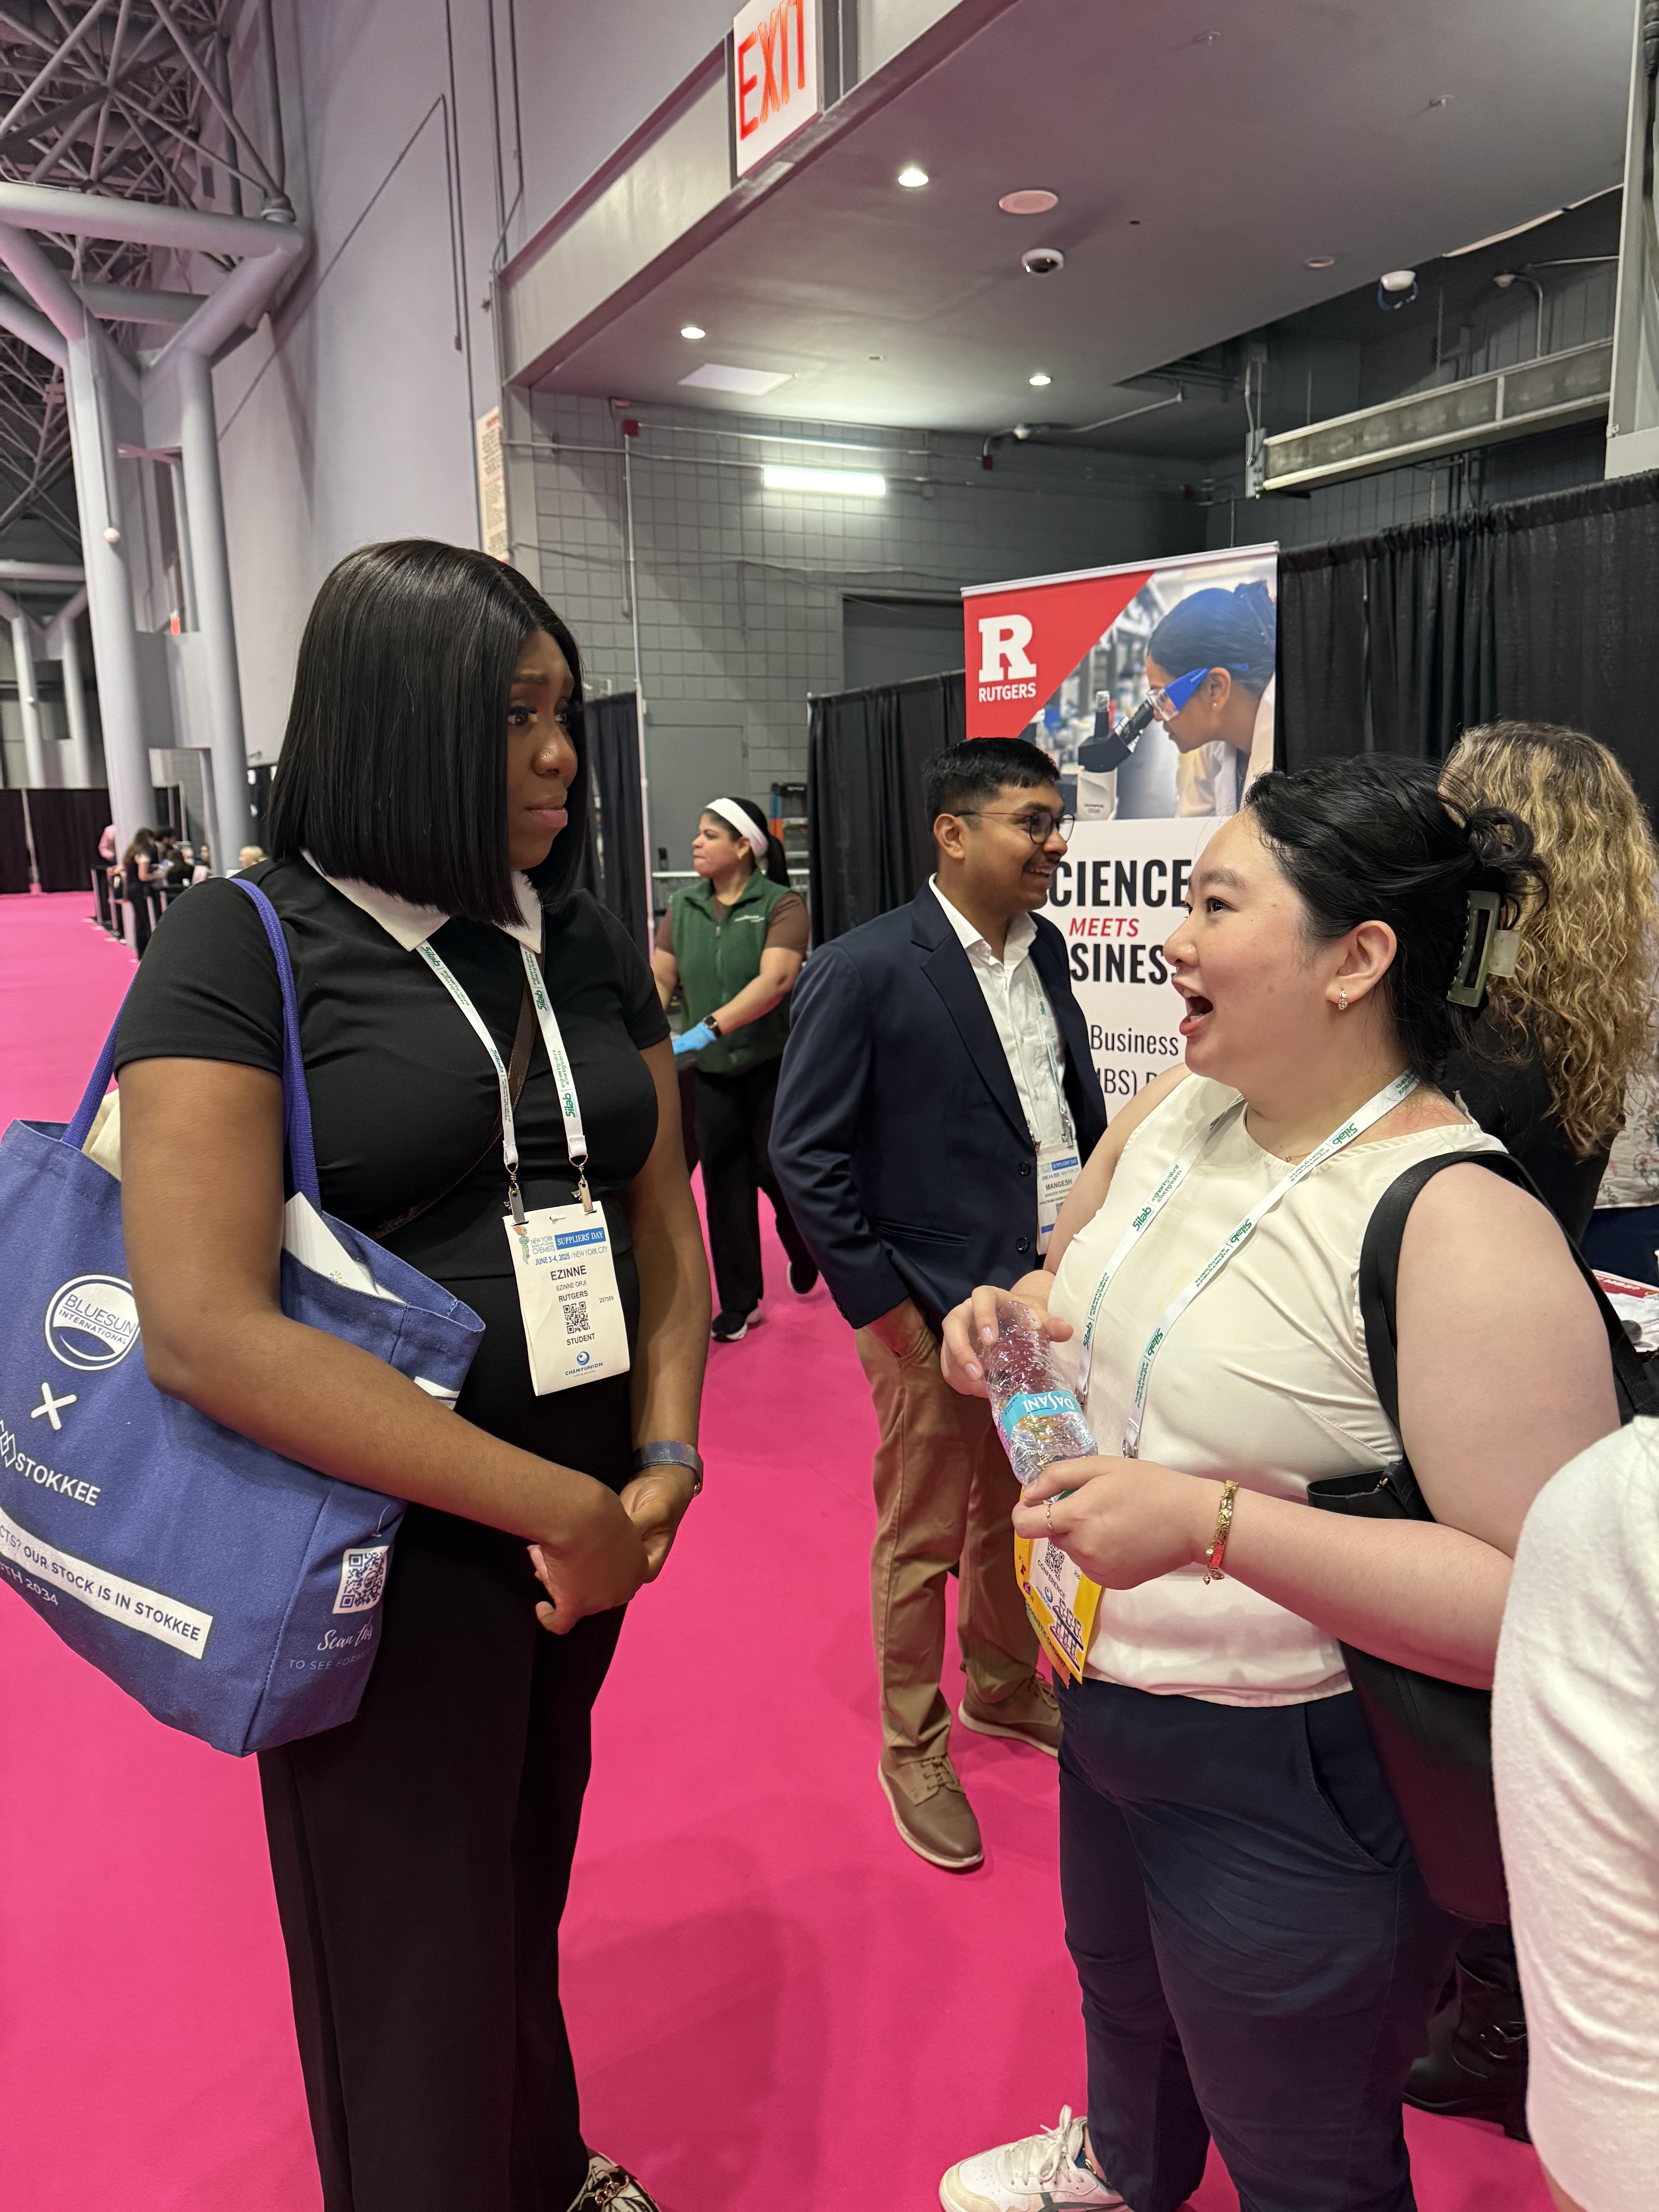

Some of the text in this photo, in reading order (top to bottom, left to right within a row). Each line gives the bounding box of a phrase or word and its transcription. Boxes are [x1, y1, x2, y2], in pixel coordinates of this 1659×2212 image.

[738, 0, 805, 141] EXIT
[978, 614, 1037, 683] R
[978, 682, 1037, 703] RUTGERS
[1049, 859, 1192, 907] CIENCE
[1069, 918, 1139, 938] MEETS
[421, 946, 441, 966] Silab
[1070, 943, 1176, 985] SINES
[534, 990, 547, 1011] Silab
[1090, 1025, 1178, 1056] Business
[490, 1048, 503, 1072] Silab
[562, 1093, 575, 1118] Silab
[1332, 1123, 1358, 1145] Silab
[1045, 1178, 1072, 1190] MANGESH
[1132, 1207, 1152, 1232] Silab
[1231, 1218, 1252, 1243] Silab
[591, 1231, 603, 1240] DAY
[532, 1245, 555, 1254] CHEMISTS
[535, 1257, 548, 1265] JUNE
[558, 1253, 570, 1261] 2025
[585, 1248, 598, 1256] YORK
[598, 1246, 608, 1254] CITY
[550, 1265, 587, 1281] EZINNE
[556, 1283, 574, 1291] EZINNE
[558, 1290, 588, 1302] RUTGERS
[65, 1294, 136, 1335] BLUESUN
[58, 1309, 127, 1345] INTERNATIONAL
[1083, 1322, 1092, 1350] Silab
[567, 1333, 595, 1345] STUDENT
[1147, 1328, 1163, 1356] Silab
[565, 1362, 603, 1376] CHEMYUNION
[1022, 1391, 1075, 1413] DASANI
[15, 1453, 101, 1506] STOKKEE
[1037, 1559, 1066, 1601] CONFERENCE
[24, 1546, 47, 1569] OUR
[52, 1562, 94, 1594] STOCK
[97, 1585, 111, 1601] IS
[115, 1593, 131, 1609] IN
[134, 1602, 201, 1641] STOKKEE
[26, 1578, 58, 1606] 2034
[317, 1629, 354, 1650] Scan
[289, 1660, 305, 1669] TO
[309, 1661, 333, 1670] SEE
